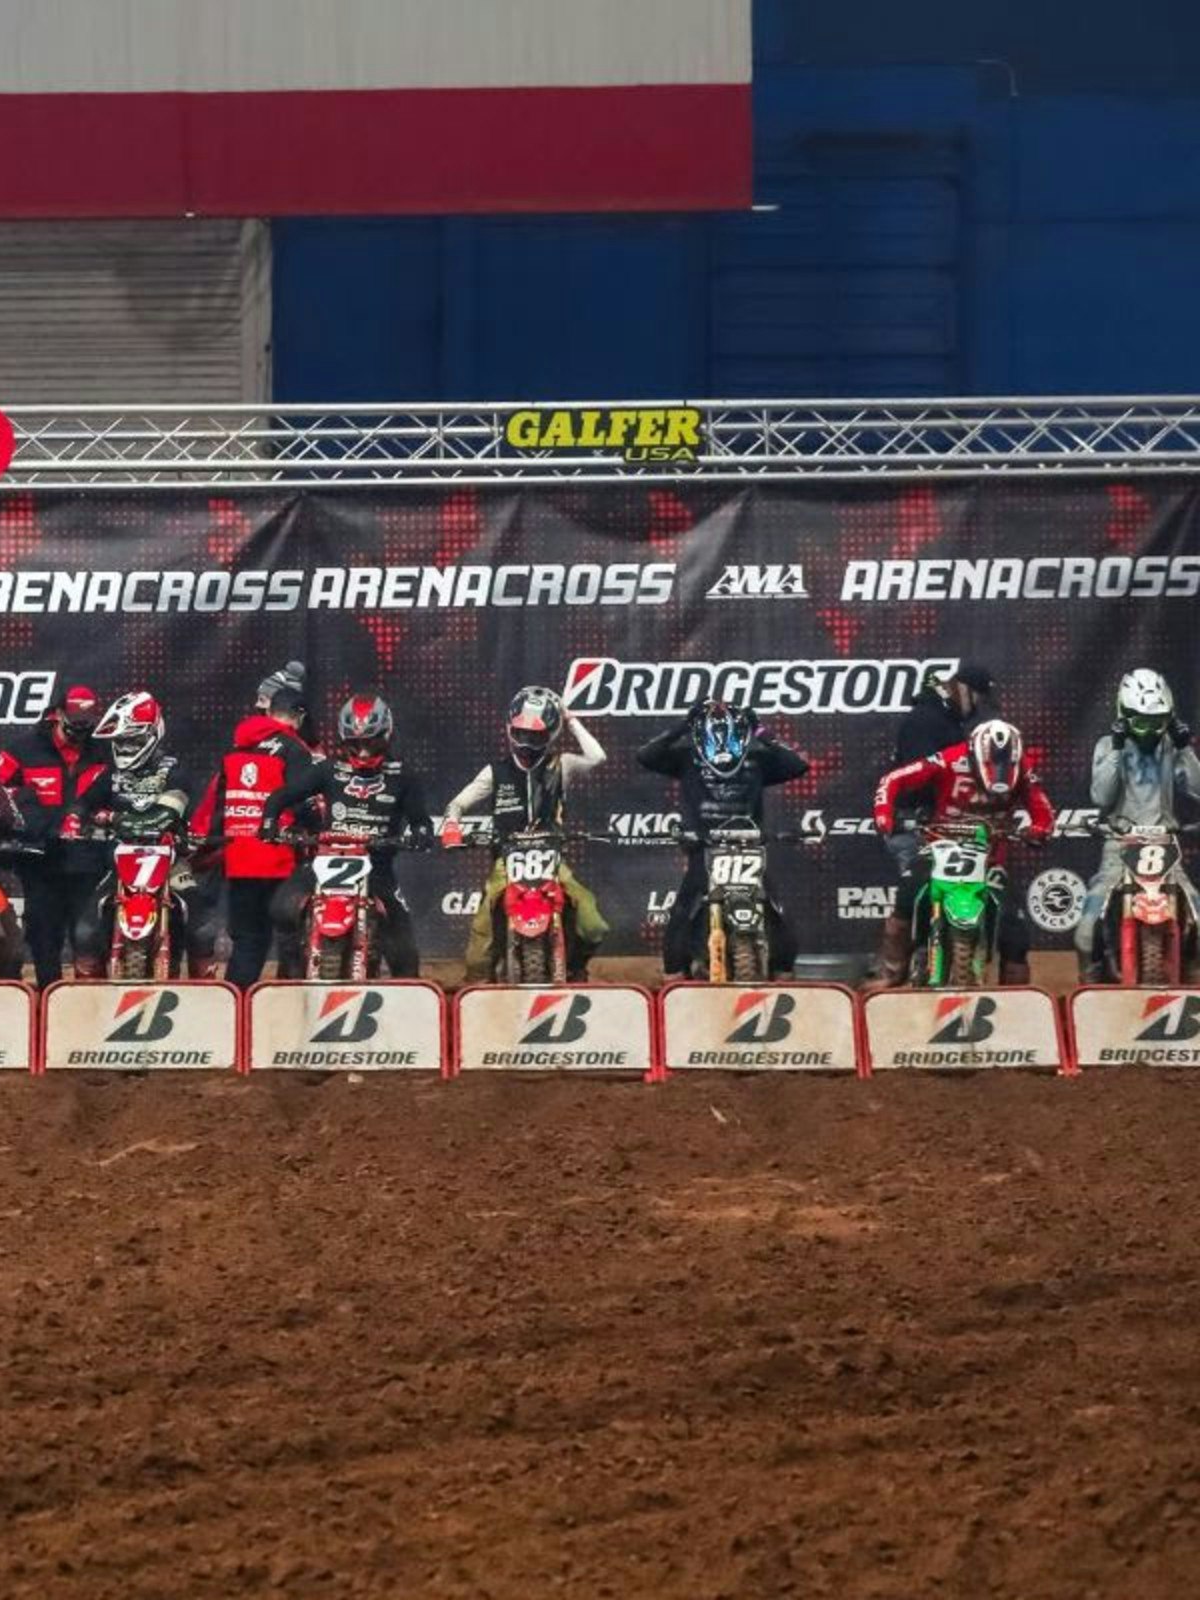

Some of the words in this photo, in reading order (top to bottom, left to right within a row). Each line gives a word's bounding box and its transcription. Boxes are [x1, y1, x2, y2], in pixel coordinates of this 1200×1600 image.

[507, 409, 700, 447] GALFER
[624, 447, 694, 461] USA
[307, 563, 676, 608] ARENACROSS
[706, 564, 809, 595] AMA
[840, 555, 1200, 600] ARENACROSS
[133, 855, 162, 887] 1
[322, 857, 366, 888] 2
[711, 855, 762, 885] 812
[944, 851, 977, 877] 5
[1137, 845, 1166, 875] 8
[68, 1050, 213, 1065] BRIDGESTONE
[273, 1050, 417, 1065] BRIDGESTONE
[483, 1051, 628, 1066] BRIDGESTONE
[687, 1051, 833, 1066] BRIDGESTONE
[893, 1049, 1038, 1065] BRIDGESTONE
[1099, 1047, 1200, 1062] BRIDGEST
